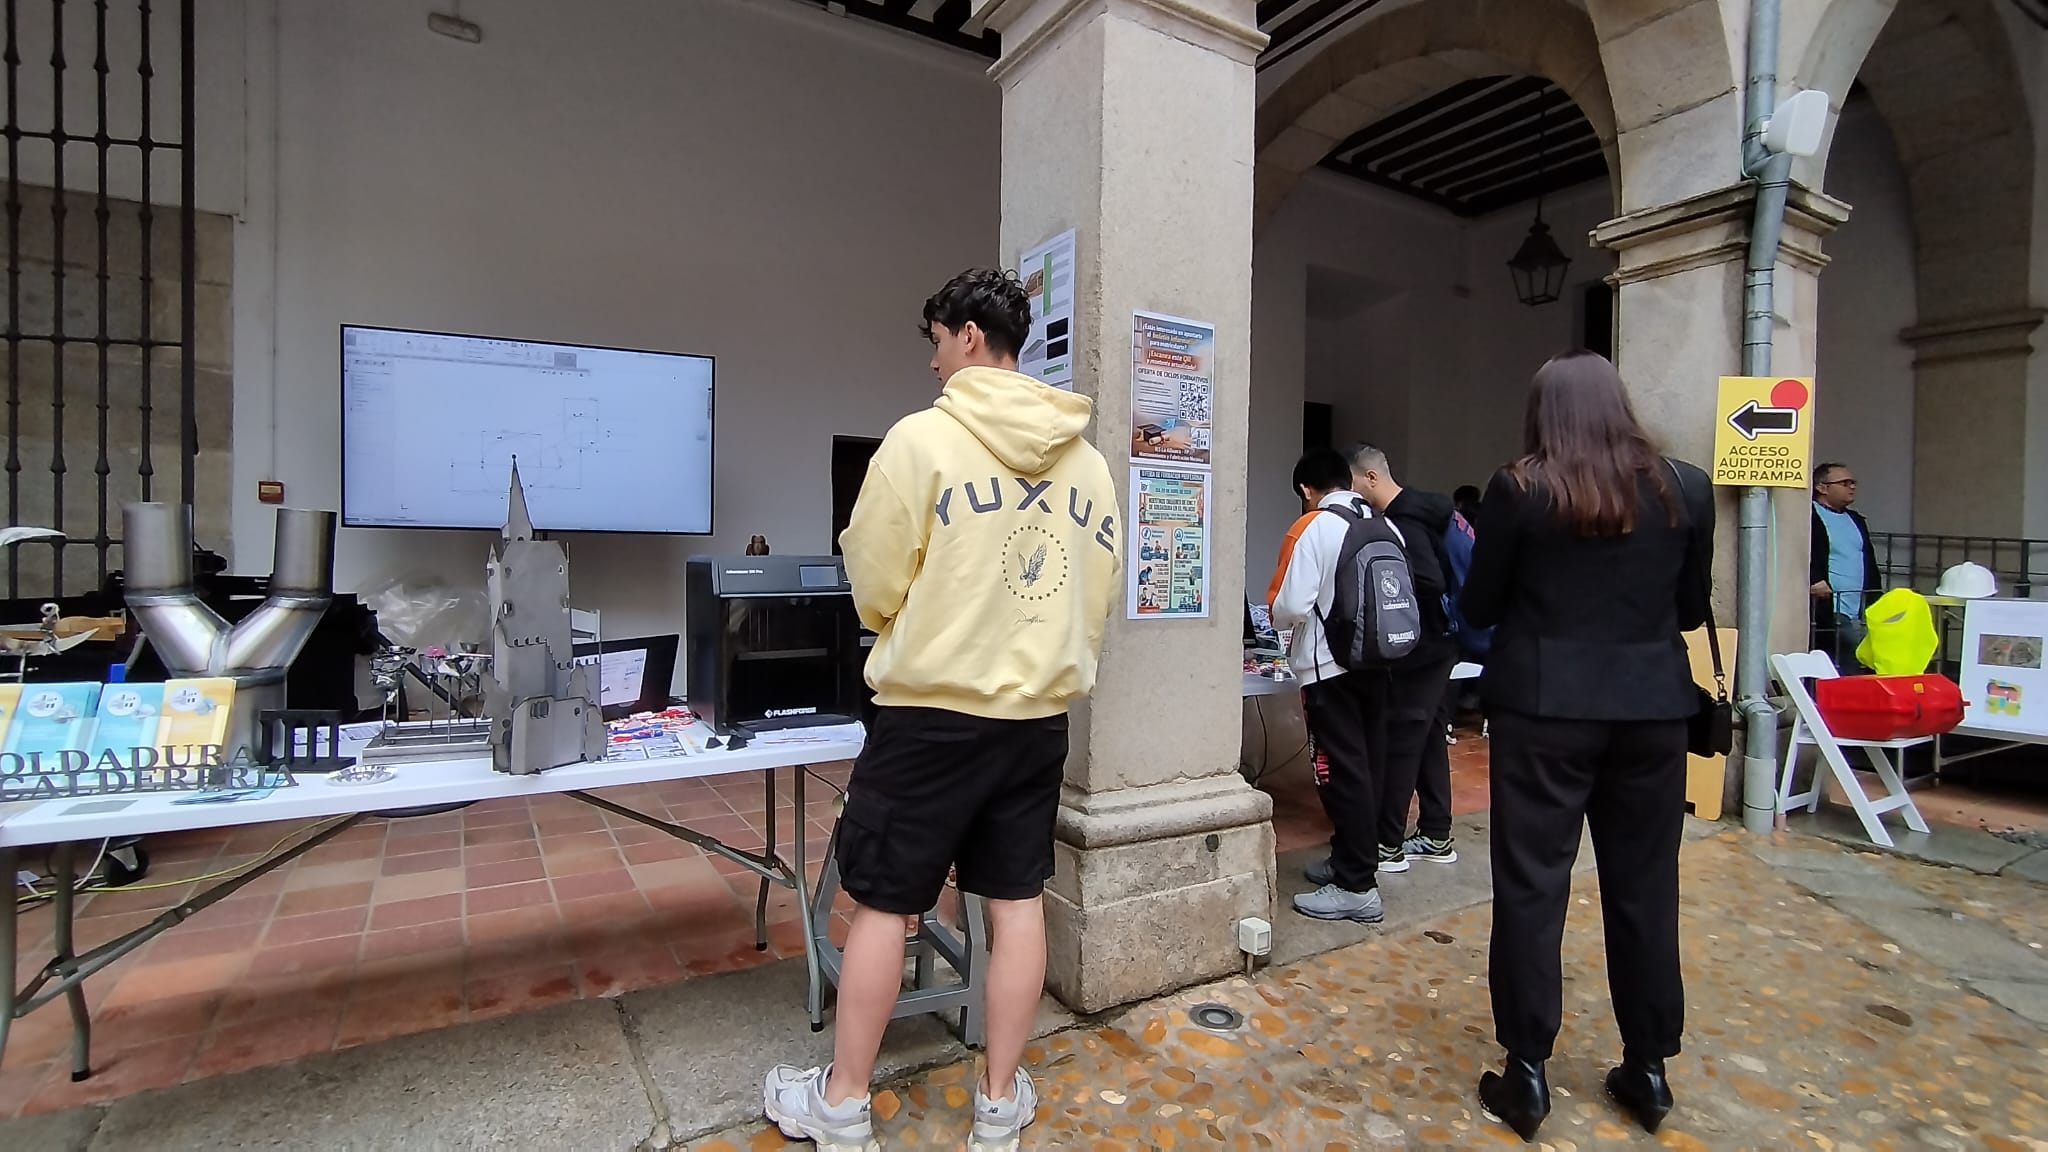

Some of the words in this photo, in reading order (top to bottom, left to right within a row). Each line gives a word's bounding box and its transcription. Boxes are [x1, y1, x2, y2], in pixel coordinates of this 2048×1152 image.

[1180, 374, 1208, 383] FORMATIVOS
[1729, 446, 1789, 456] ACCESO
[1719, 458, 1802, 469] AUDITORIO
[1717, 470, 1746, 480] POR
[1750, 470, 1804, 481] RAMPA
[935, 476, 1114, 554] YUXUS
[773, 706, 817, 717] FLASHFORGE
